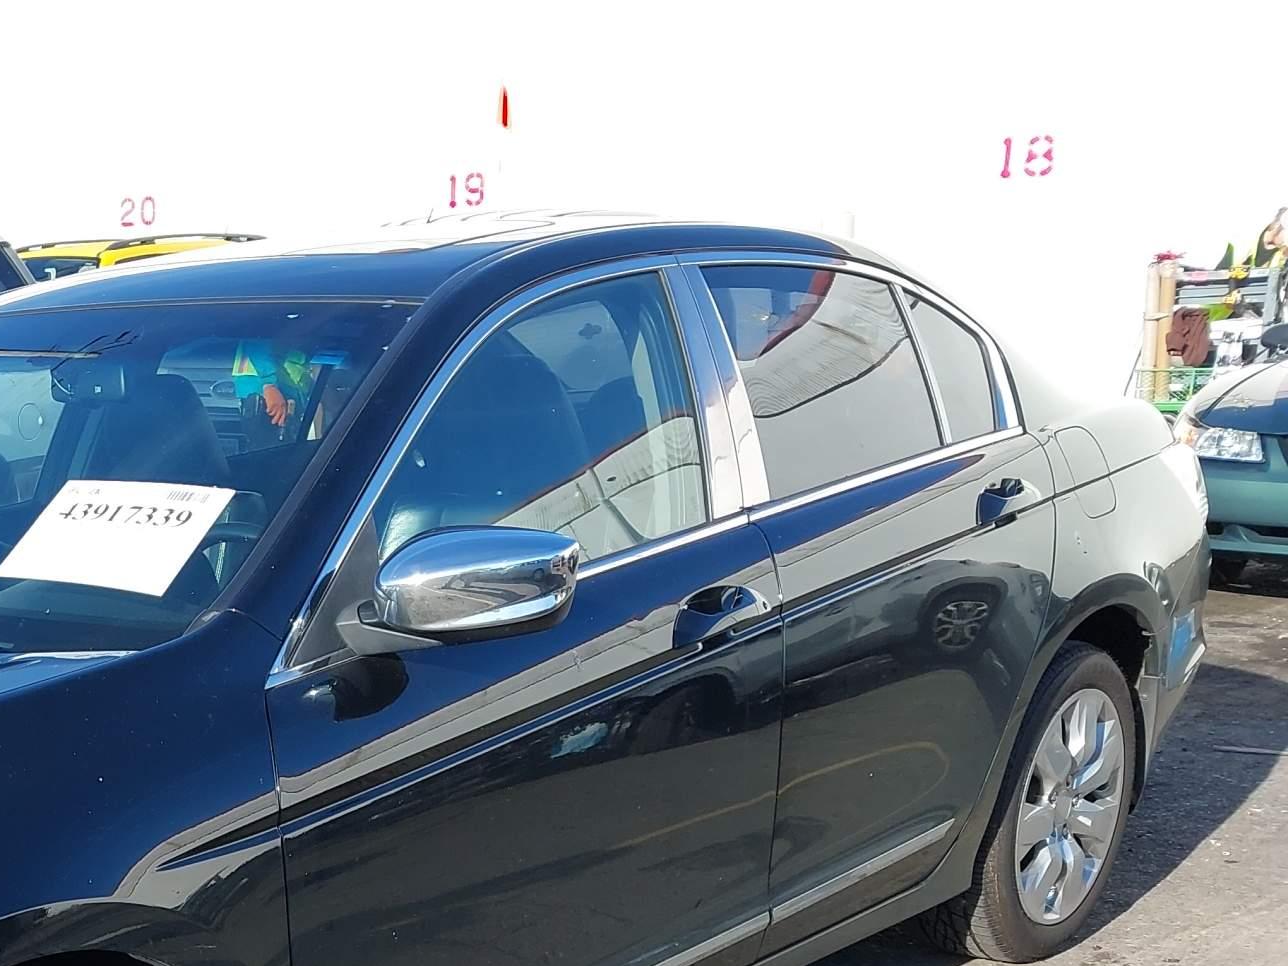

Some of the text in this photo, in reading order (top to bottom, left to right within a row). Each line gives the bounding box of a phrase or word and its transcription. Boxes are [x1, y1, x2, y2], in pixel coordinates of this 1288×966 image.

[1000, 135, 1054, 178] 18
[449, 172, 484, 208] 19
[120, 196, 156, 227] 20
[58, 502, 193, 528] 43917339
